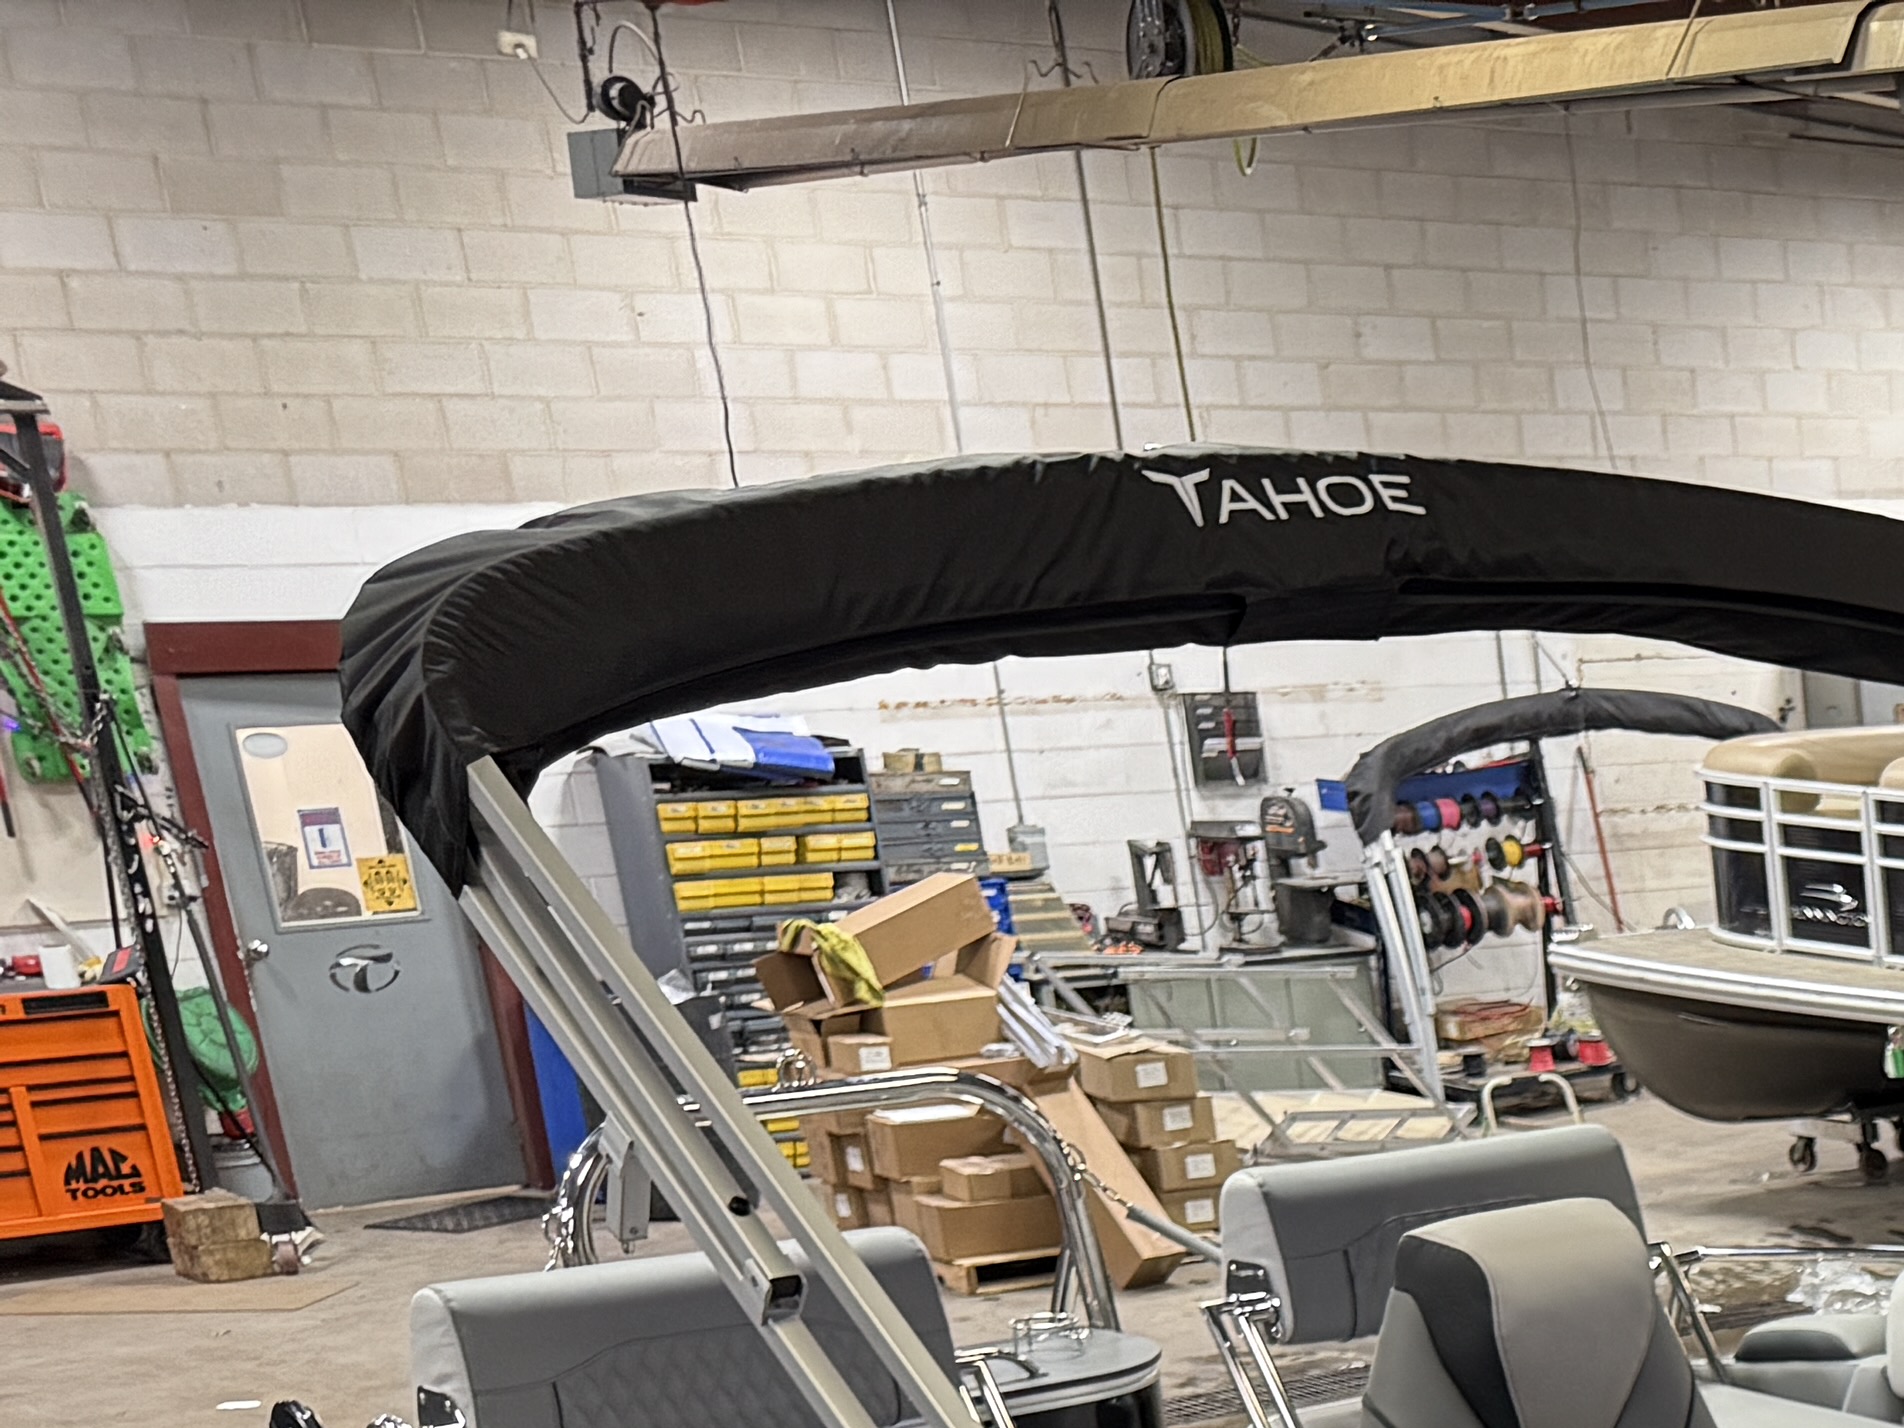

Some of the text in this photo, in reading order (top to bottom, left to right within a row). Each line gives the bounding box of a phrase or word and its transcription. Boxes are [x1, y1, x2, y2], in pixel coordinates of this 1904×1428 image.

[1141, 467, 1427, 528] TAHOE
[64, 1146, 142, 1186] MAC
[65, 1181, 147, 1201] TOOLS
